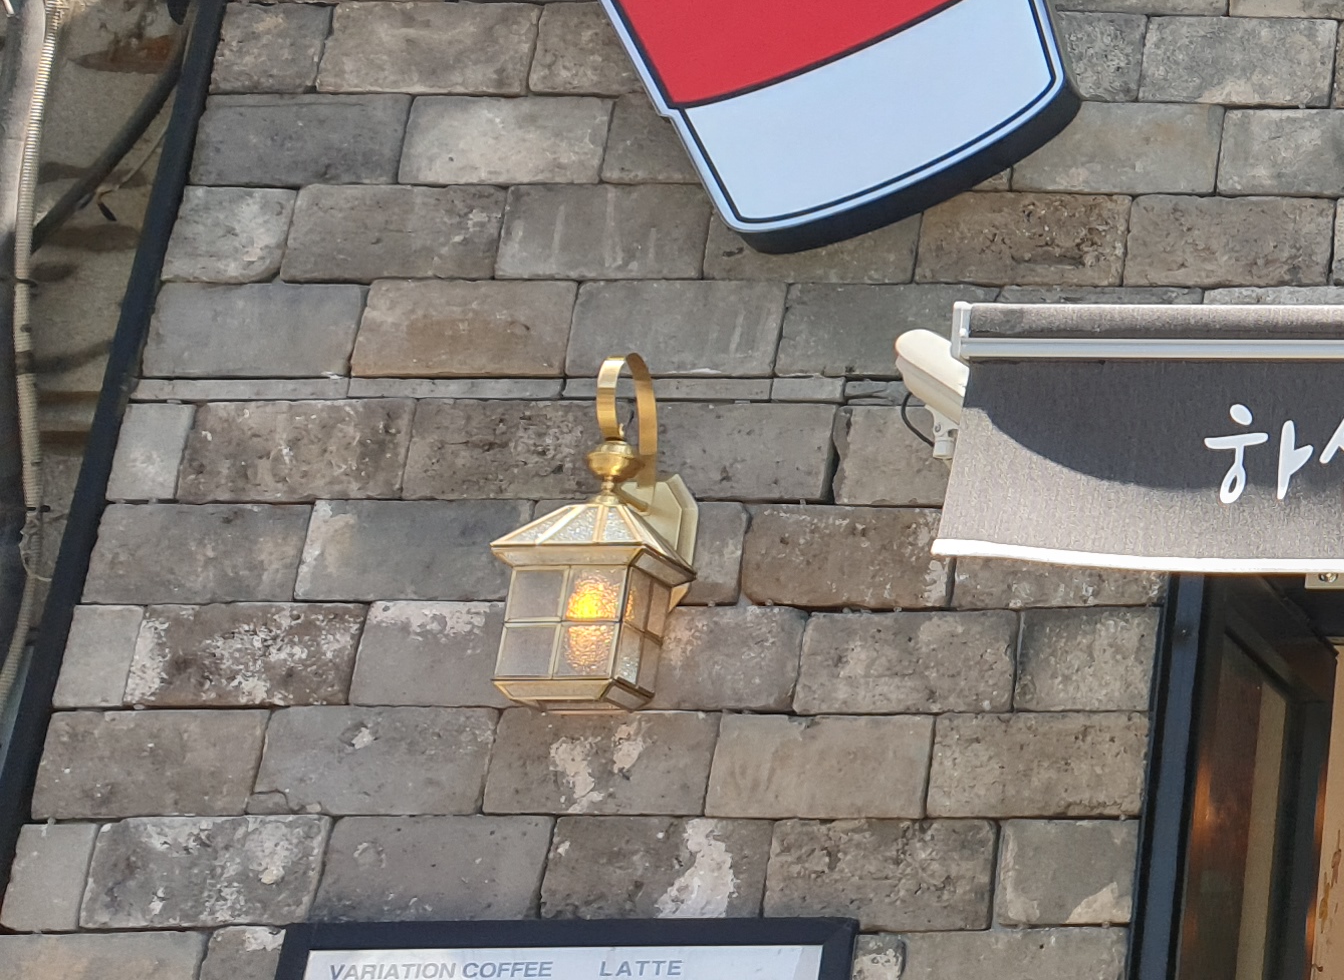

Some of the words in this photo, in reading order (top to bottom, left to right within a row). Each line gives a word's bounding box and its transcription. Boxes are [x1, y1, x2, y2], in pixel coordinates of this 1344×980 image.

[329, 962, 457, 980] VARIATION
[461, 961, 553, 979] COFFEE
[600, 960, 683, 977] LATTE
